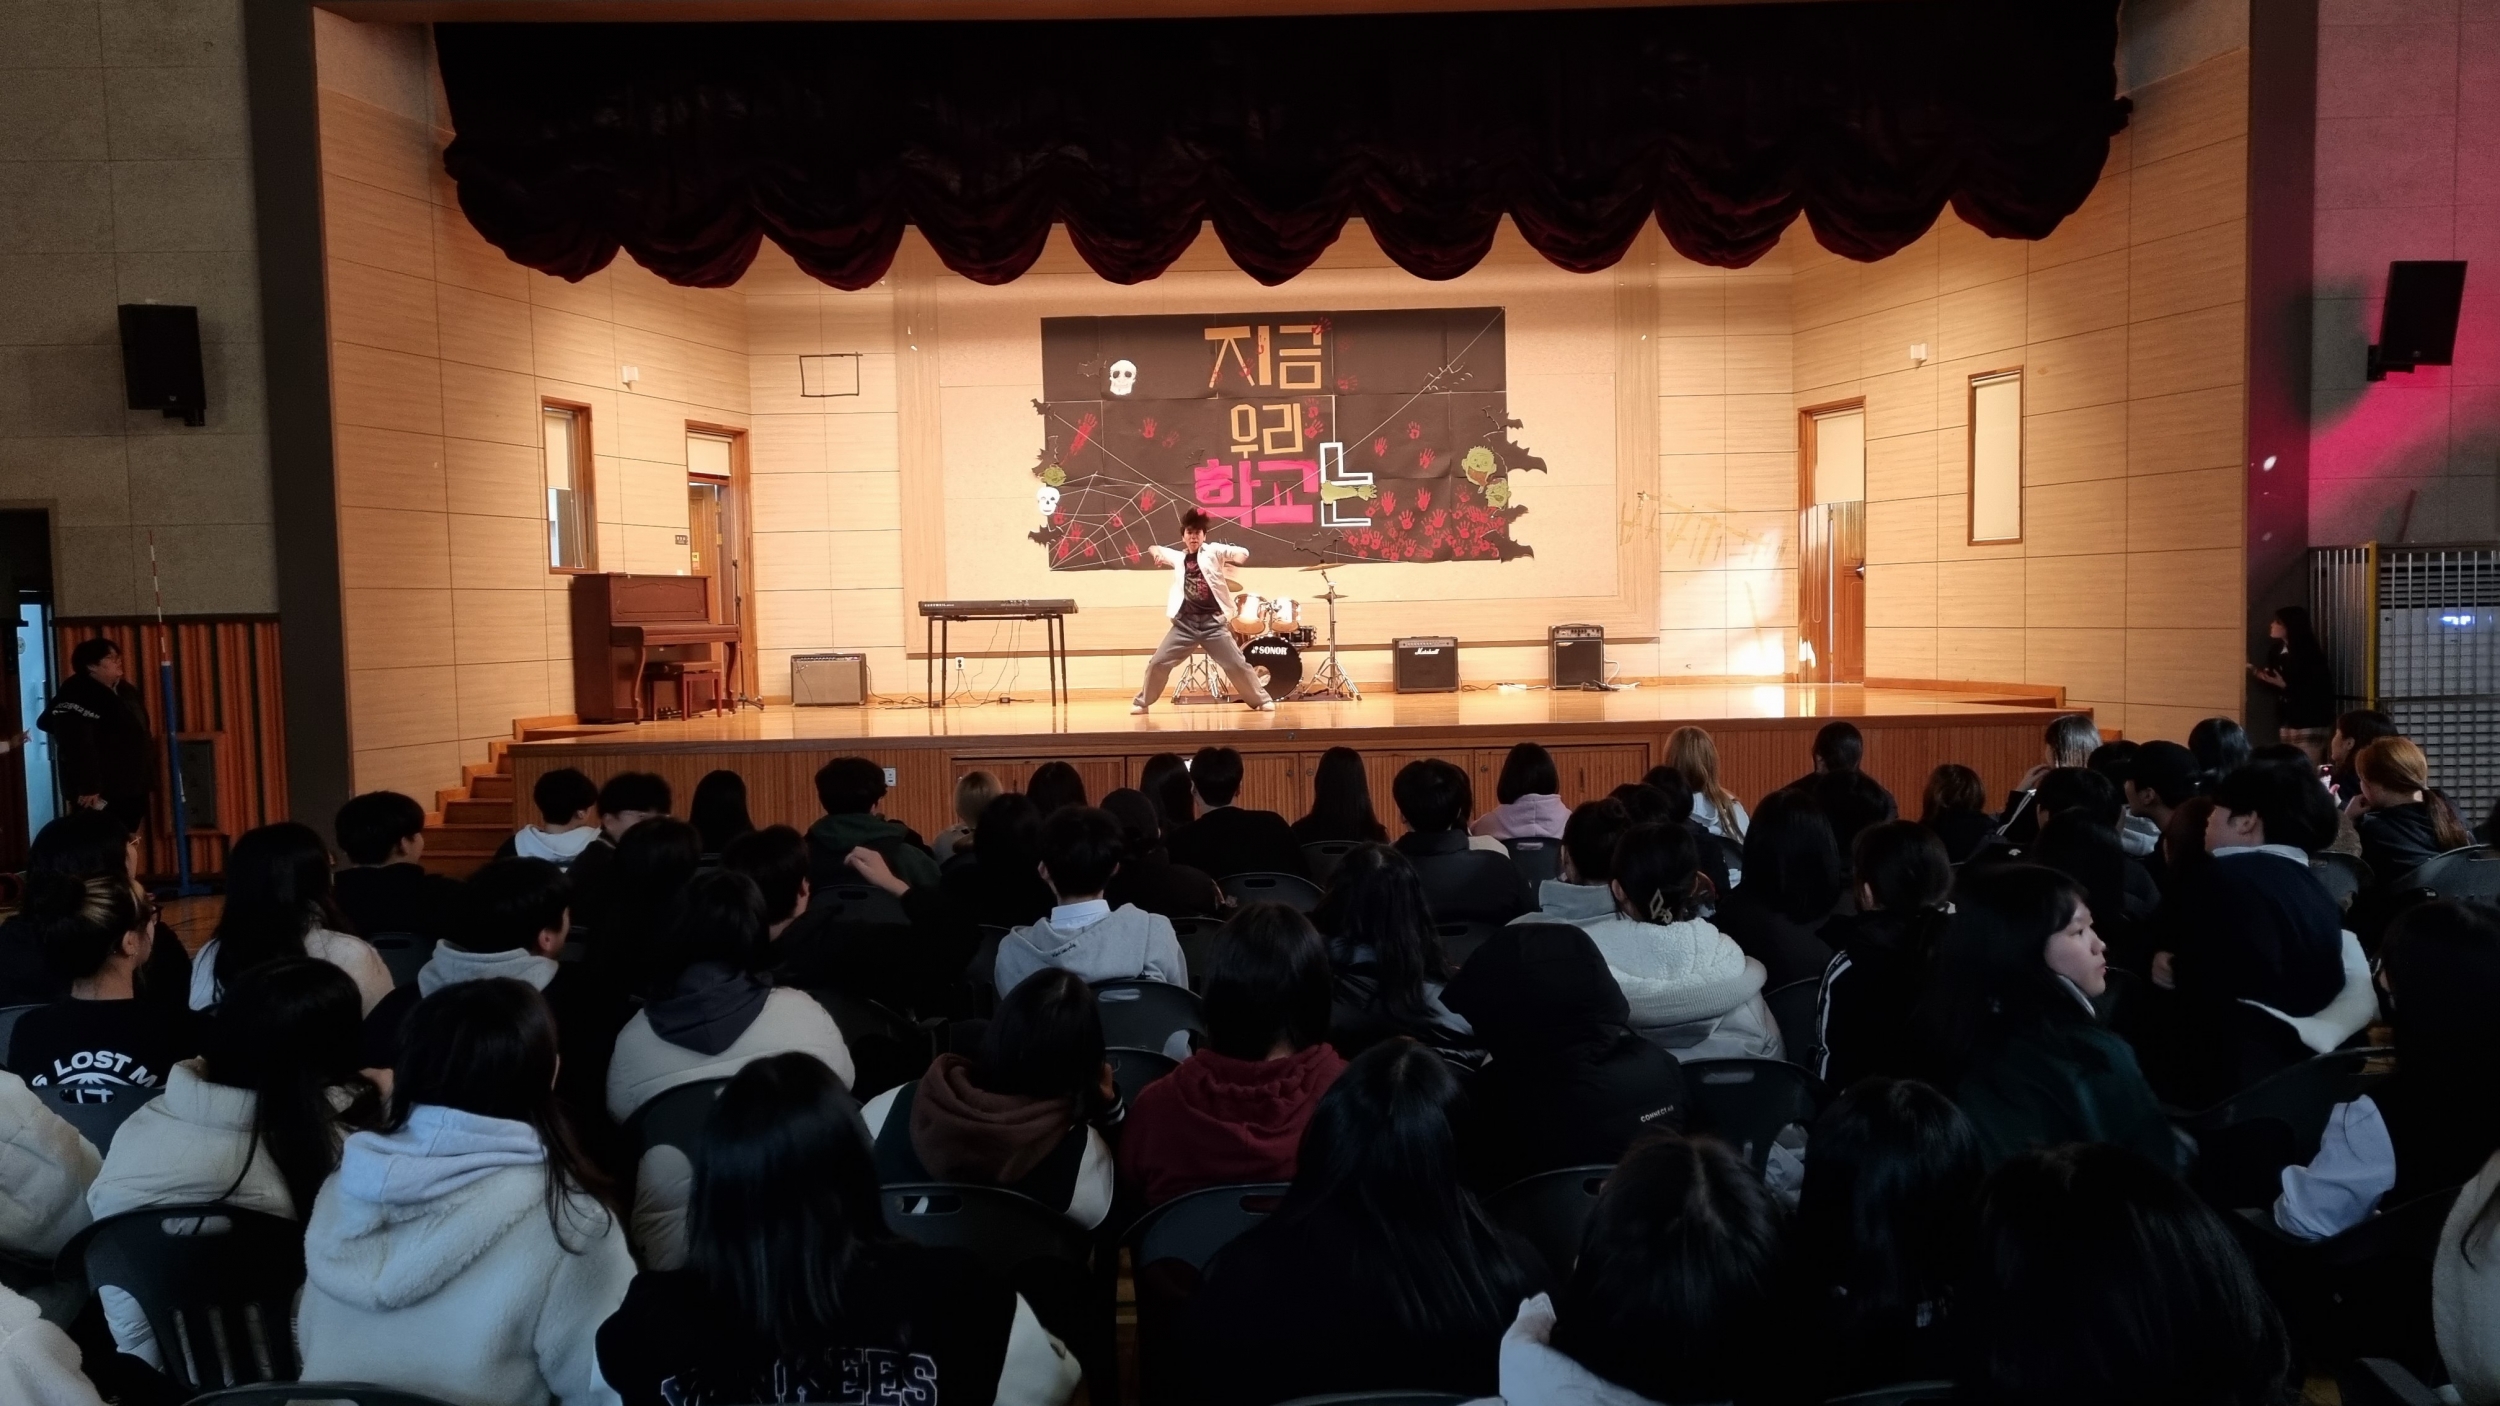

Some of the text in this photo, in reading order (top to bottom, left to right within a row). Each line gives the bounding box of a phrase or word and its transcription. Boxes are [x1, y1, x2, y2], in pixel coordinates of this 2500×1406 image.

[1204, 325, 1322, 388] 지금
[1230, 403, 1303, 459] 우리
[1258, 645, 1288, 656] SONOR
[53, 1050, 133, 1077] LOST
